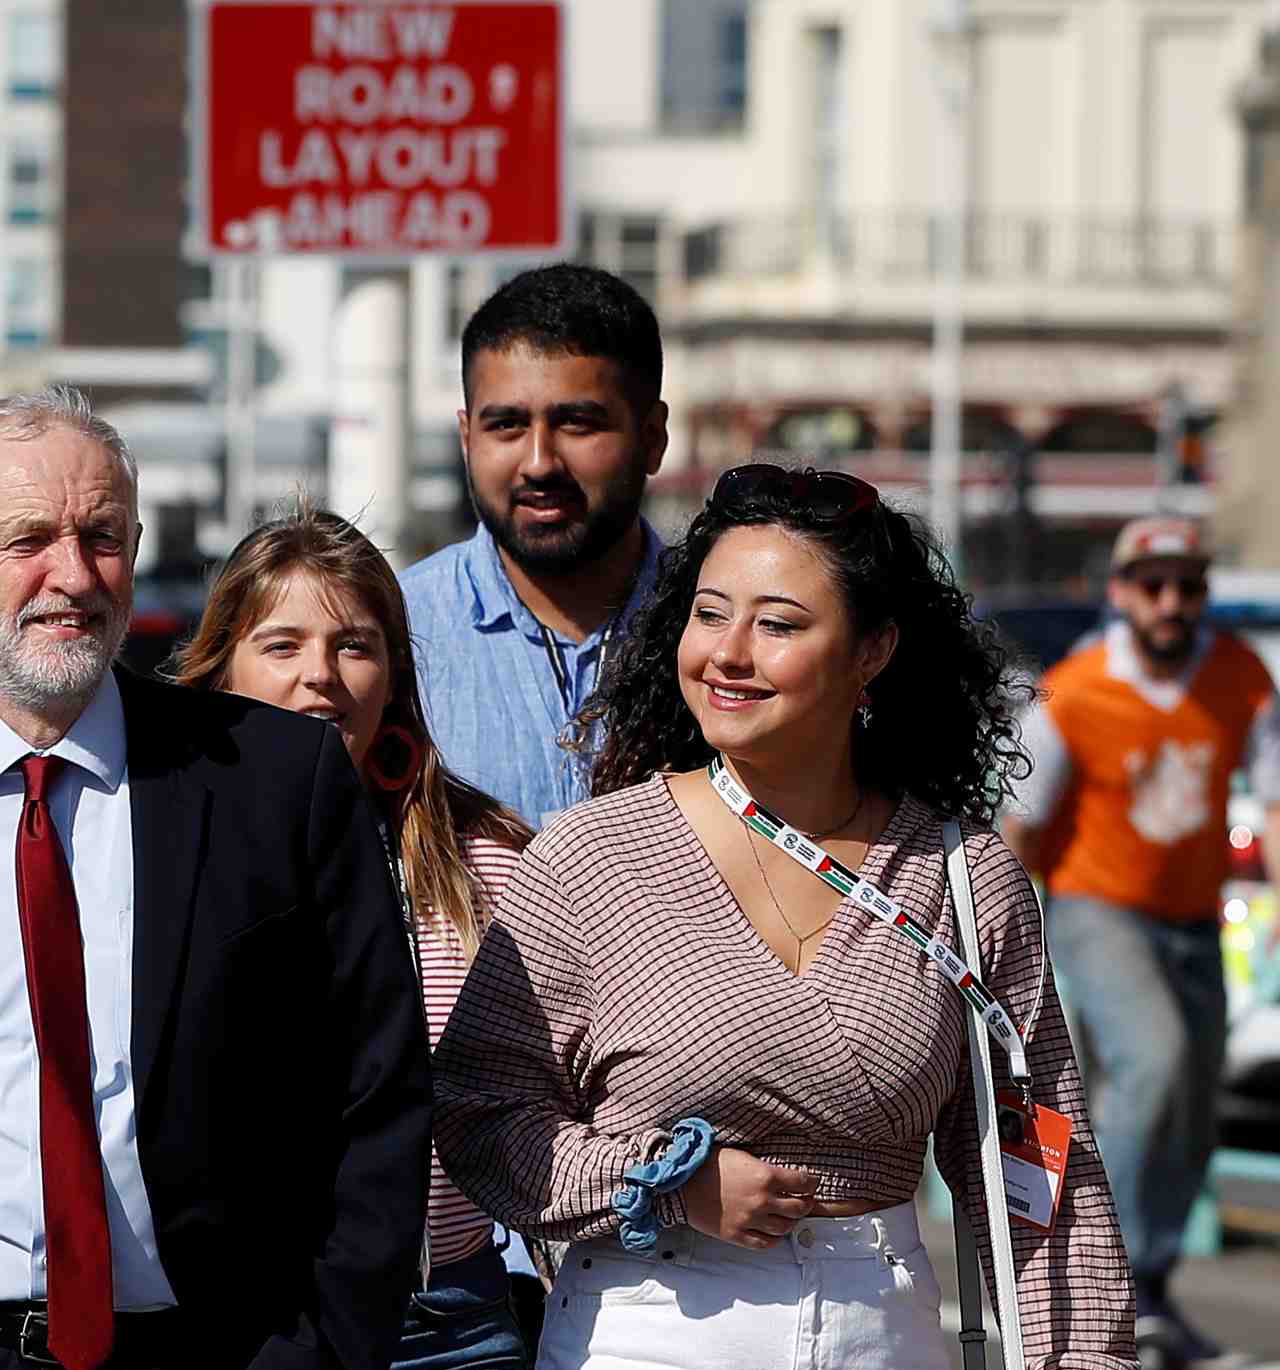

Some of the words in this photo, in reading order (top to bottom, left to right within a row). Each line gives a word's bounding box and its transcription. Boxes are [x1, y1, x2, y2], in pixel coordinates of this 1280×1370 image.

[311, 7, 456, 59] NEW
[293, 63, 475, 125] ROAD
[257, 126, 507, 189] LAYOUT
[285, 189, 491, 249] AHEAD
